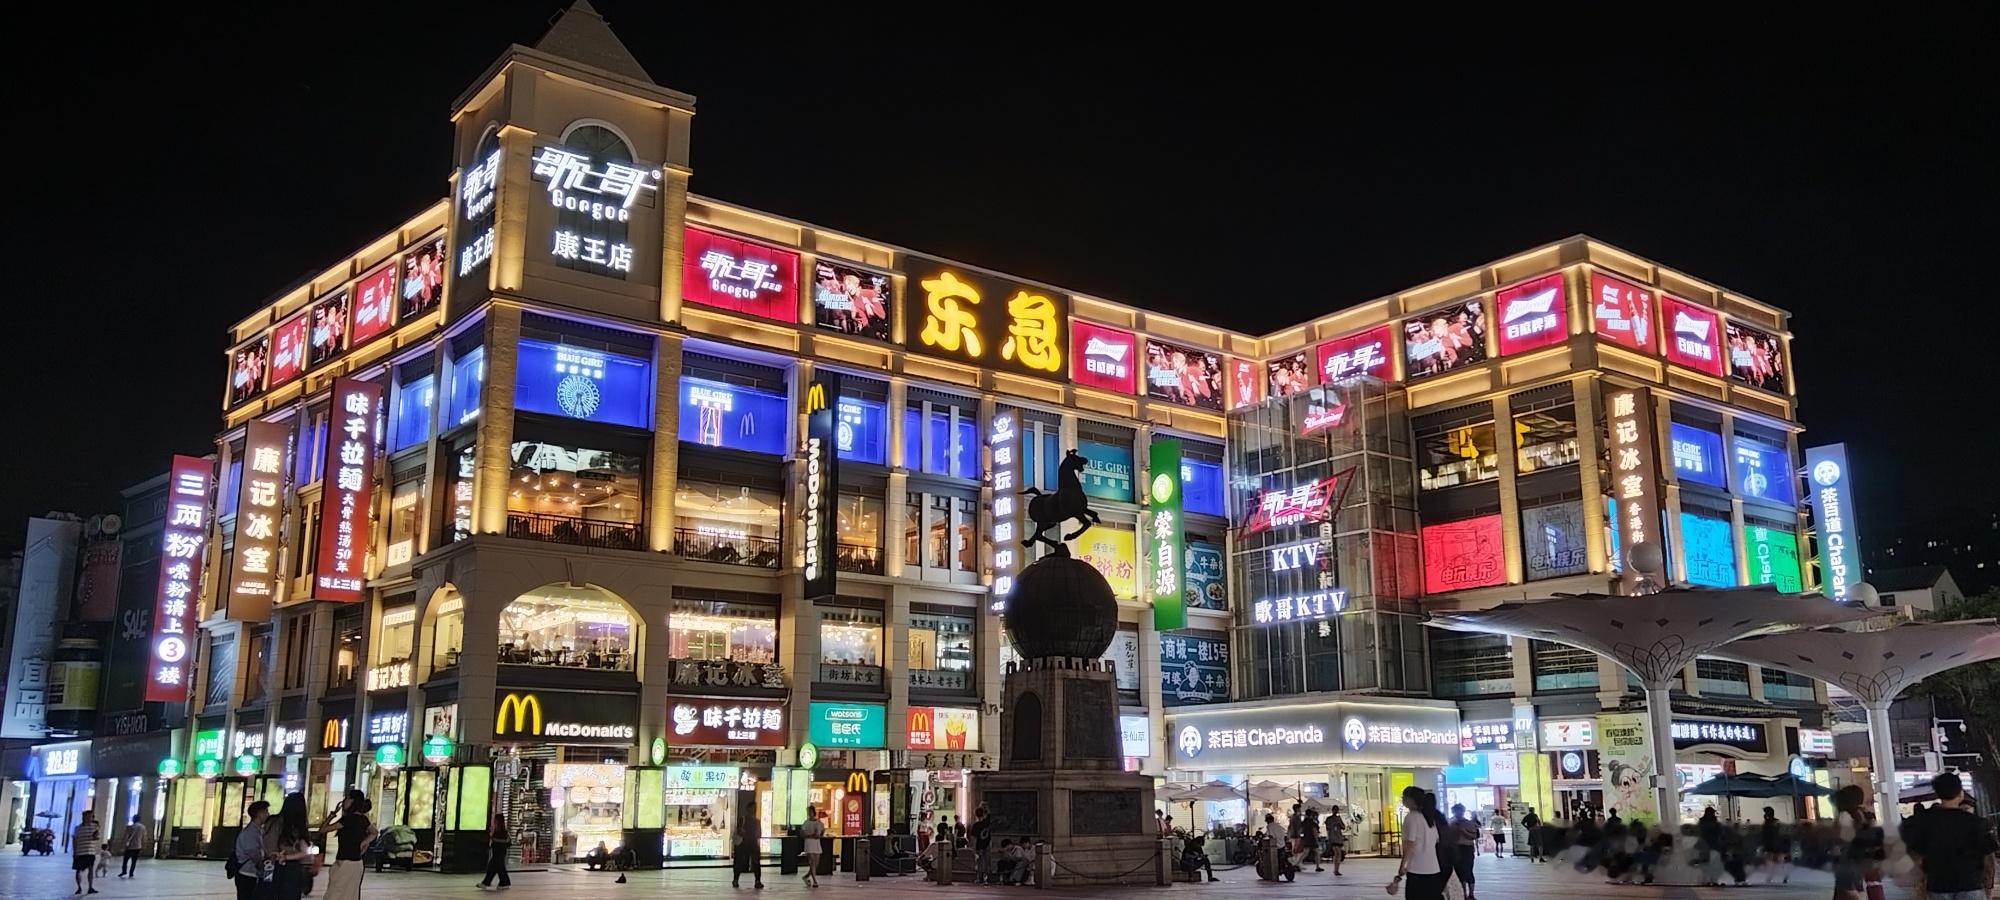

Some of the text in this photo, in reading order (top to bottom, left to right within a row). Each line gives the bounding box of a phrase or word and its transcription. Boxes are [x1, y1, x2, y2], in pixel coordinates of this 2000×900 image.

[531, 146, 657, 208] 歌哥
[551, 231, 633, 273] 康王店
[920, 271, 1062, 373] 东急
[1508, 314, 1557, 339] 百威啤酒
[556, 351, 580, 363] BLUE
[1678, 336, 1712, 361] 百威啤酒
[1086, 358, 1126, 378] 百威啤酒
[1614, 393, 1644, 499] 廉记冰室
[1083, 458, 1129, 475] LUE GIRL
[165, 473, 204, 559] 三两粉
[242, 446, 281, 573] 廉记冰室
[805, 437, 821, 581] McDonald's
[994, 446, 1012, 596] 电玩体验中心
[1629, 503, 1644, 544] 香港街
[1821, 487, 1842, 533] 茶百道
[1154, 511, 1176, 596] 蒙自源
[1272, 541, 1320, 572] KTV
[1441, 557, 1497, 585] 电玩娱乐
[1255, 591, 1345, 623] 歌哥KTV
[544, 722, 634, 739] McDonald's
[830, 711, 863, 719] watsons
[831, 722, 862, 735] 屈臣氏
[1515, 718, 1533, 731] KTV
[1208, 725, 1324, 749] 茶百道 ChaPanda
[1368, 726, 1402, 744] 茶百道
[1402, 727, 1458, 745] ChaPanda
